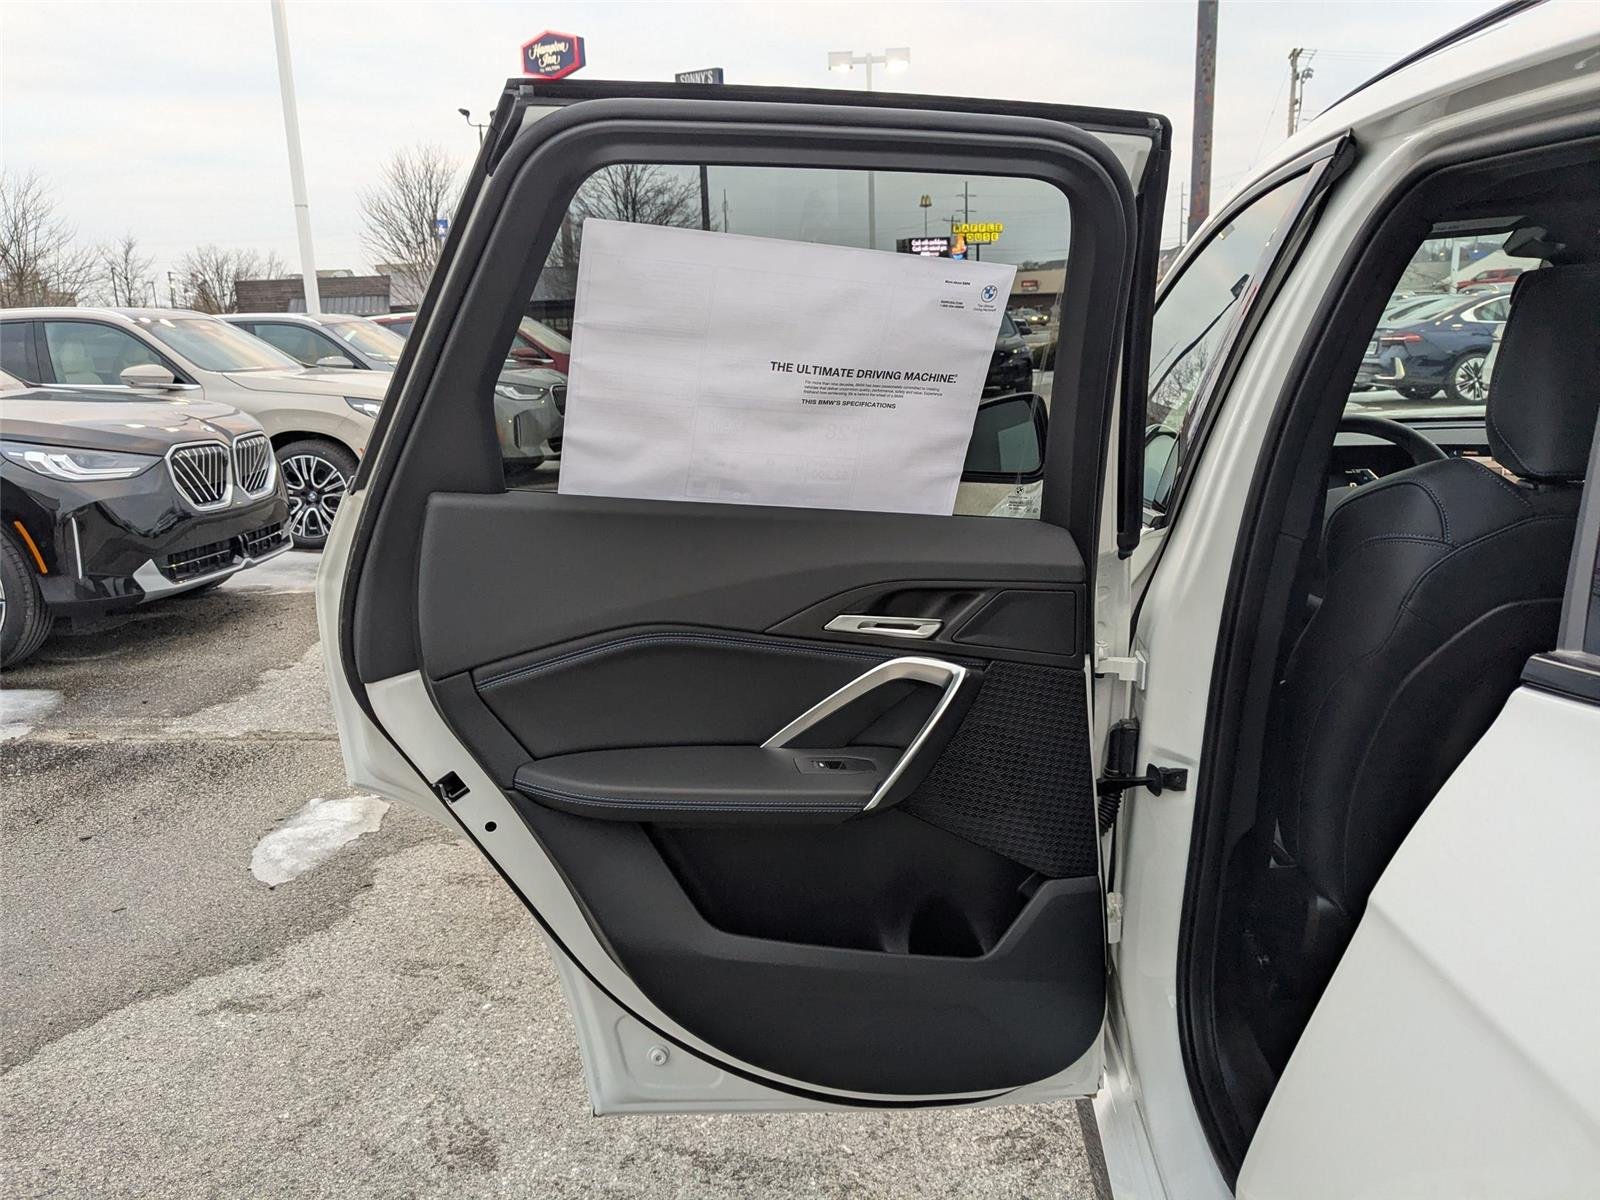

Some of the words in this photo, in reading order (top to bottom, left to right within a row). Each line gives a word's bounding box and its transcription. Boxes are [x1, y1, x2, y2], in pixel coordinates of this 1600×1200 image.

[529, 41, 569, 60] Hampton
[538, 53, 561, 68] Inn
[680, 70, 713, 84] SONNY'S
[966, 232, 999, 241] OUSE
[770, 361, 794, 373] THE
[796, 363, 855, 378] ULTIMATE
[856, 369, 902, 381] DRIVING
[841, 400, 896, 409] SPECIFICATIONS
